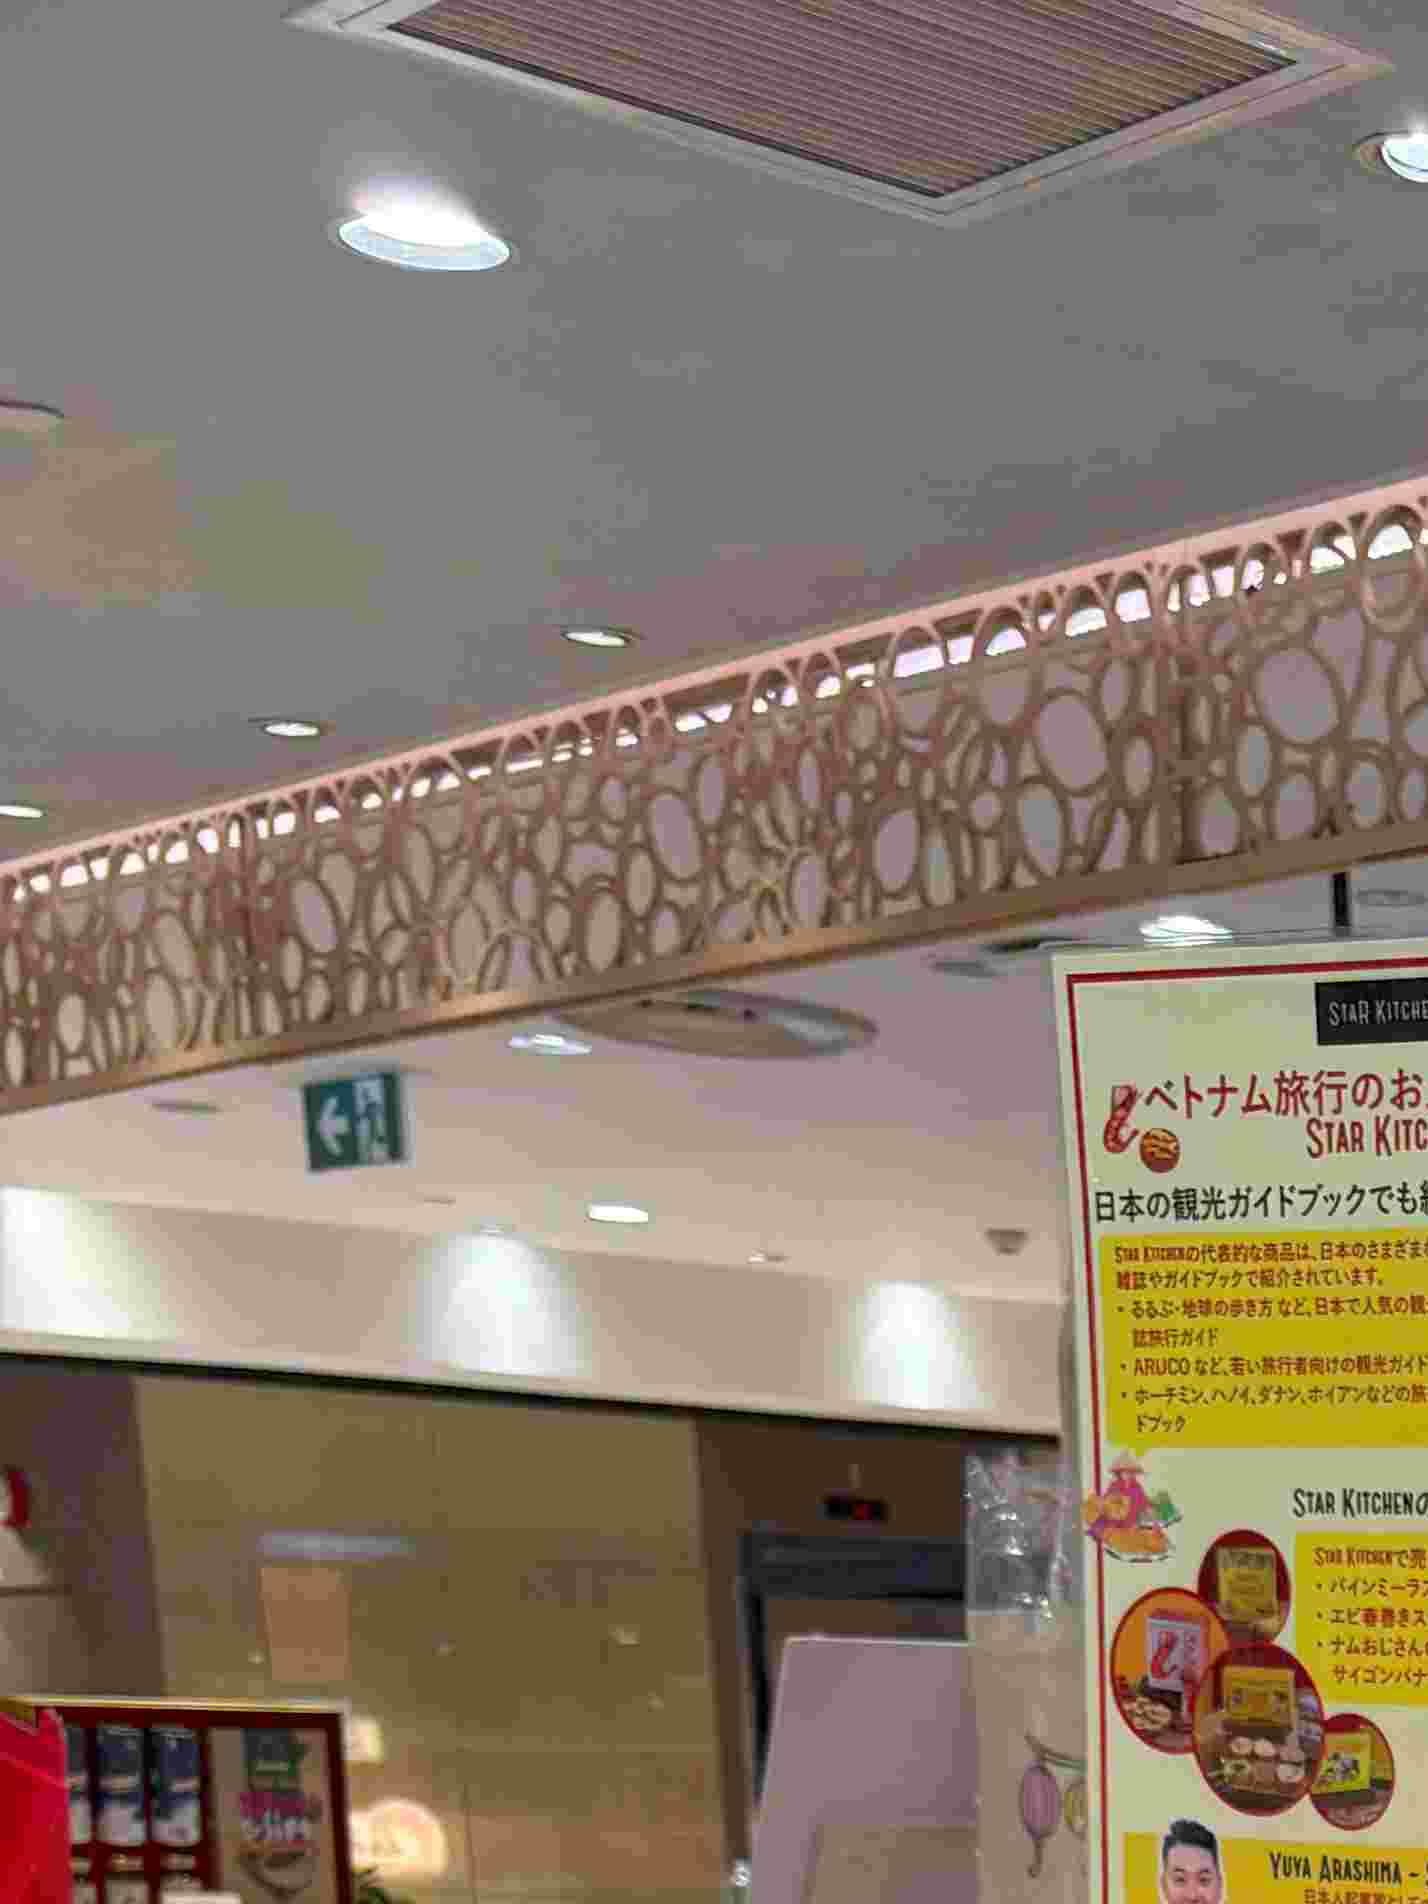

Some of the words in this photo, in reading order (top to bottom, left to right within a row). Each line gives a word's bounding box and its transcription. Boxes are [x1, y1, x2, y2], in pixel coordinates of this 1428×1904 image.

[1328, 1000, 1369, 1026] STAR
[1306, 1118, 1364, 1158] STAR
[1134, 1357, 1190, 1377] ARUCO
[1293, 1488, 1336, 1519] STAR
[1269, 1851, 1312, 1880] YUYA
[1319, 1855, 1402, 1885] ARASHIMA
